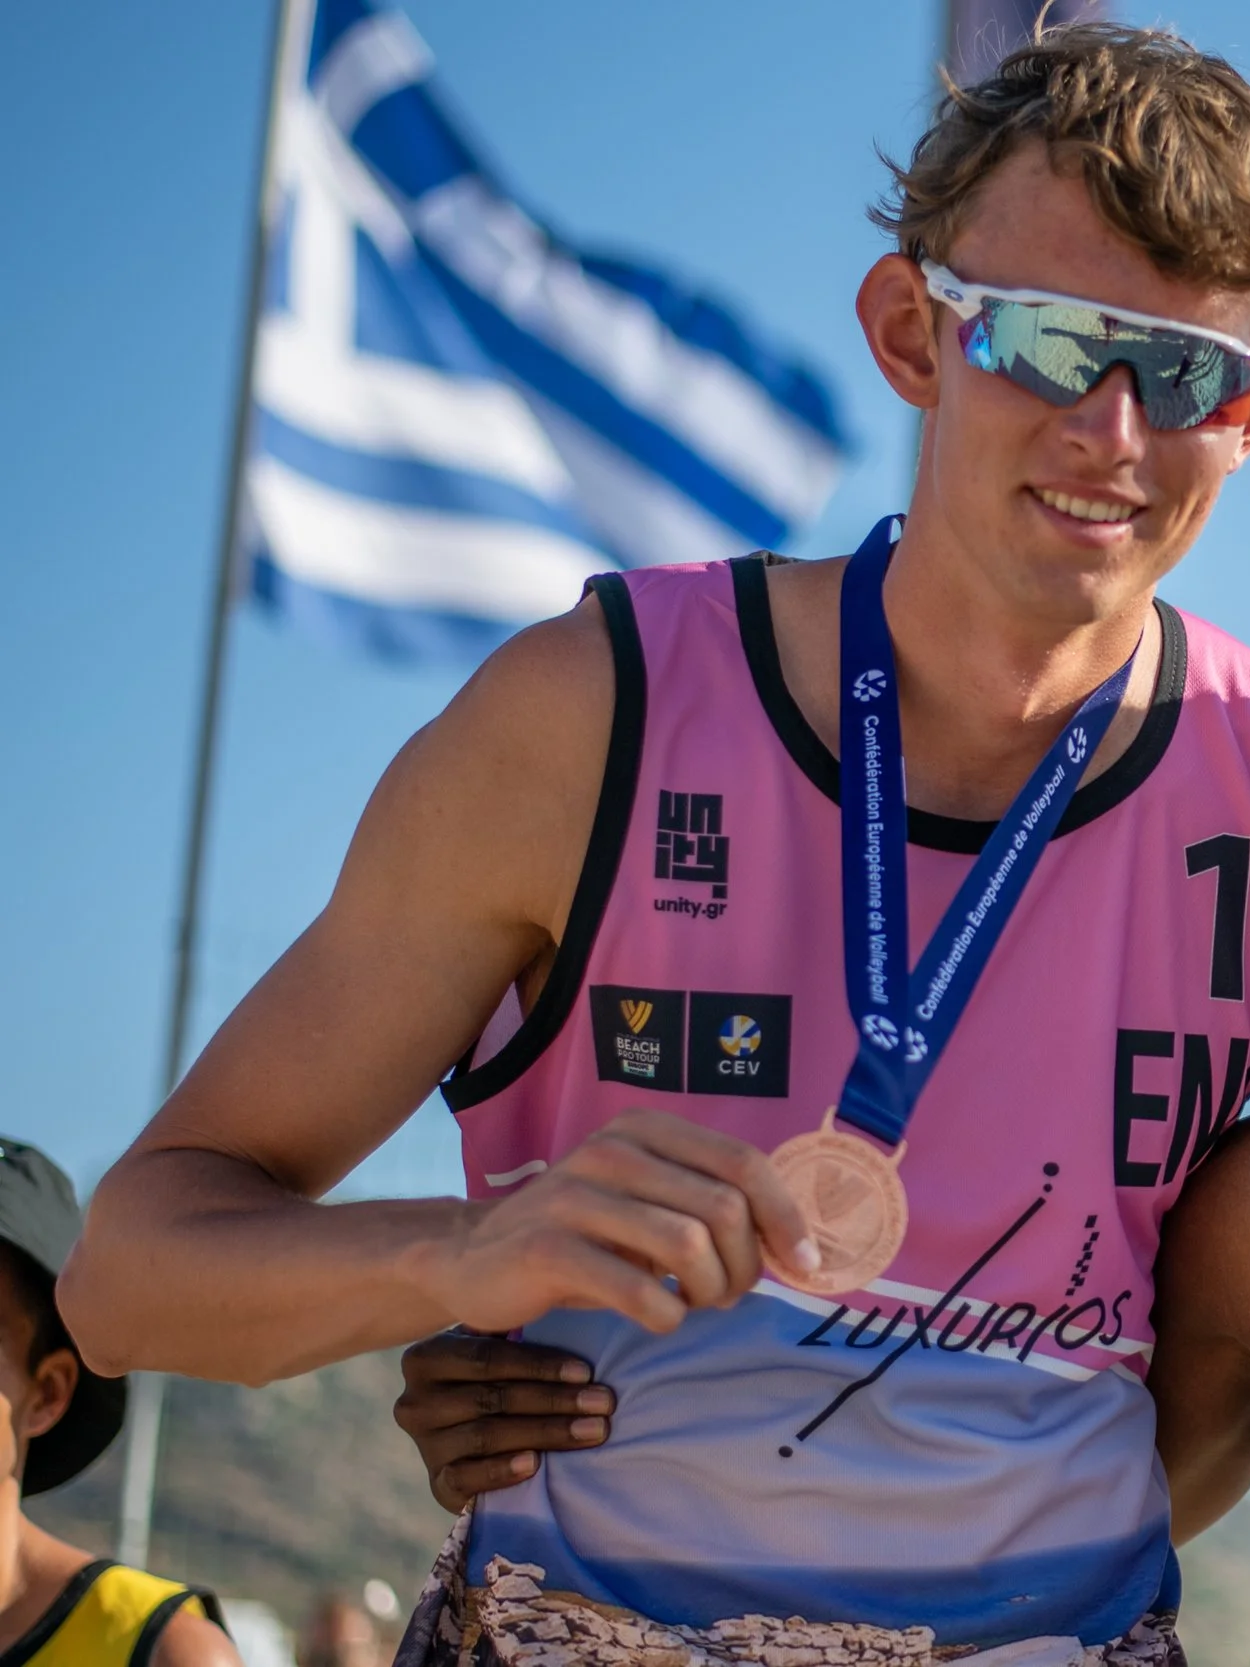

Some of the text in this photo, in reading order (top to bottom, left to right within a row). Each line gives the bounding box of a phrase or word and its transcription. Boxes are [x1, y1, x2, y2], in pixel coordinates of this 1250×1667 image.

[864, 715, 889, 1005] Confédération Européenne de Volleyball
[916, 764, 1066, 1021] Confédération Européenne de Volleyball
[653, 896, 728, 920] unity.gr
[616, 1036, 661, 1055] BEACH
[618, 1049, 661, 1064] PRO TOUR
[718, 1060, 761, 1076] CEV
